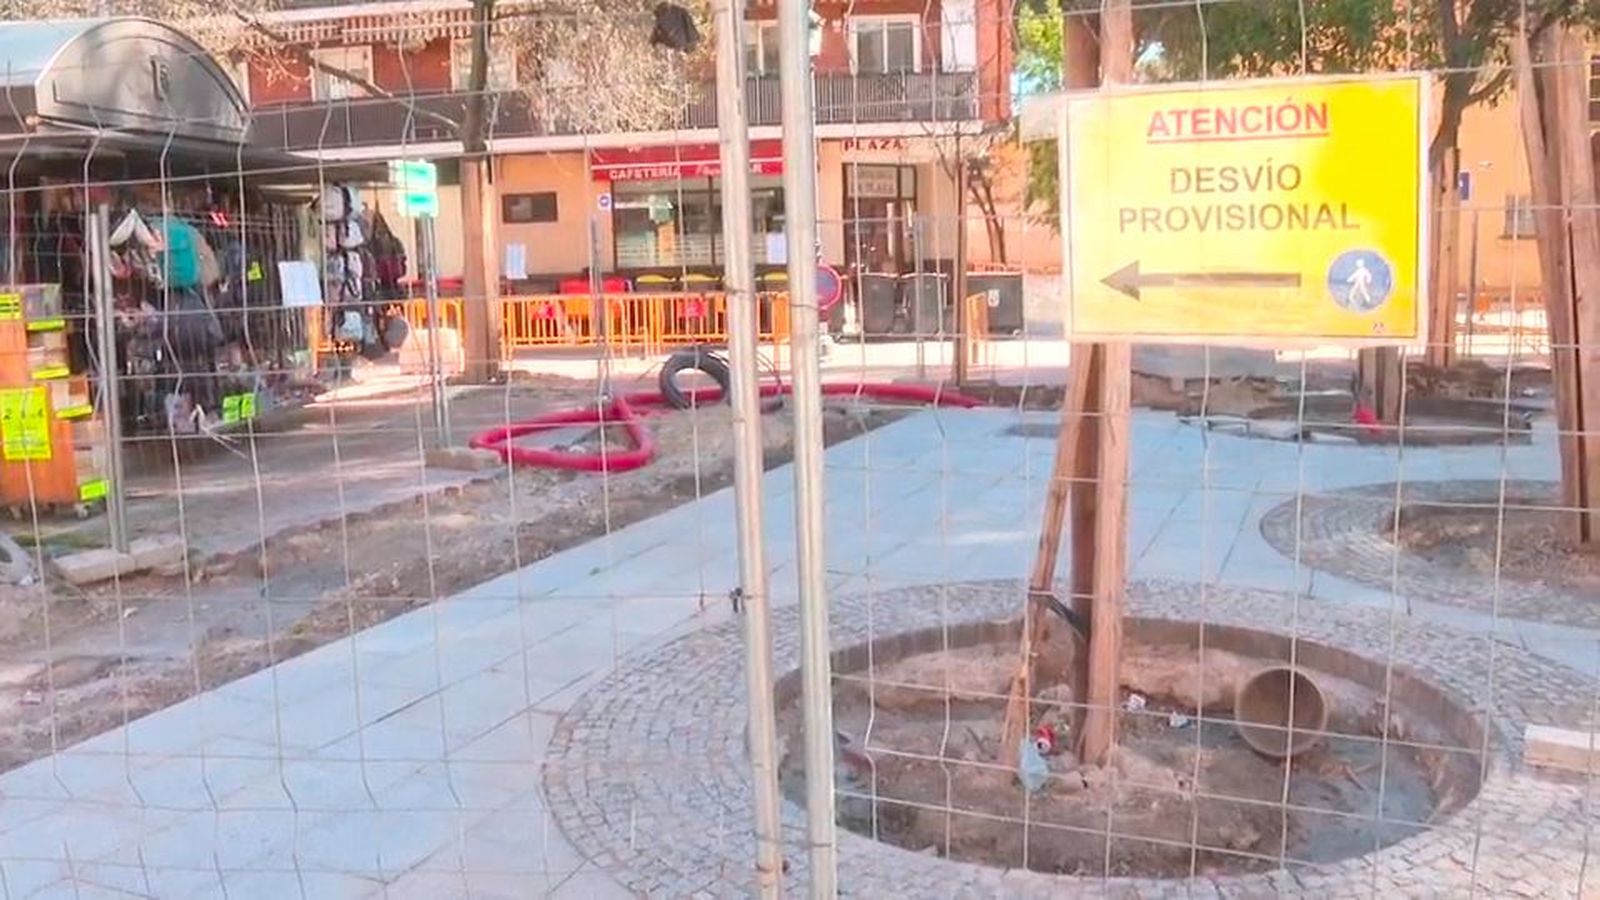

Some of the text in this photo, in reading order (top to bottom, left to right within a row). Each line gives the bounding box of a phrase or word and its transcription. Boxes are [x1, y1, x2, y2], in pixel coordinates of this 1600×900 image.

[1147, 98, 1328, 137] ATENCIÓN
[844, 139, 904, 151] PLAZA
[1170, 158, 1302, 194] DESVÍO
[1119, 202, 1361, 234] PROVISIONAL
